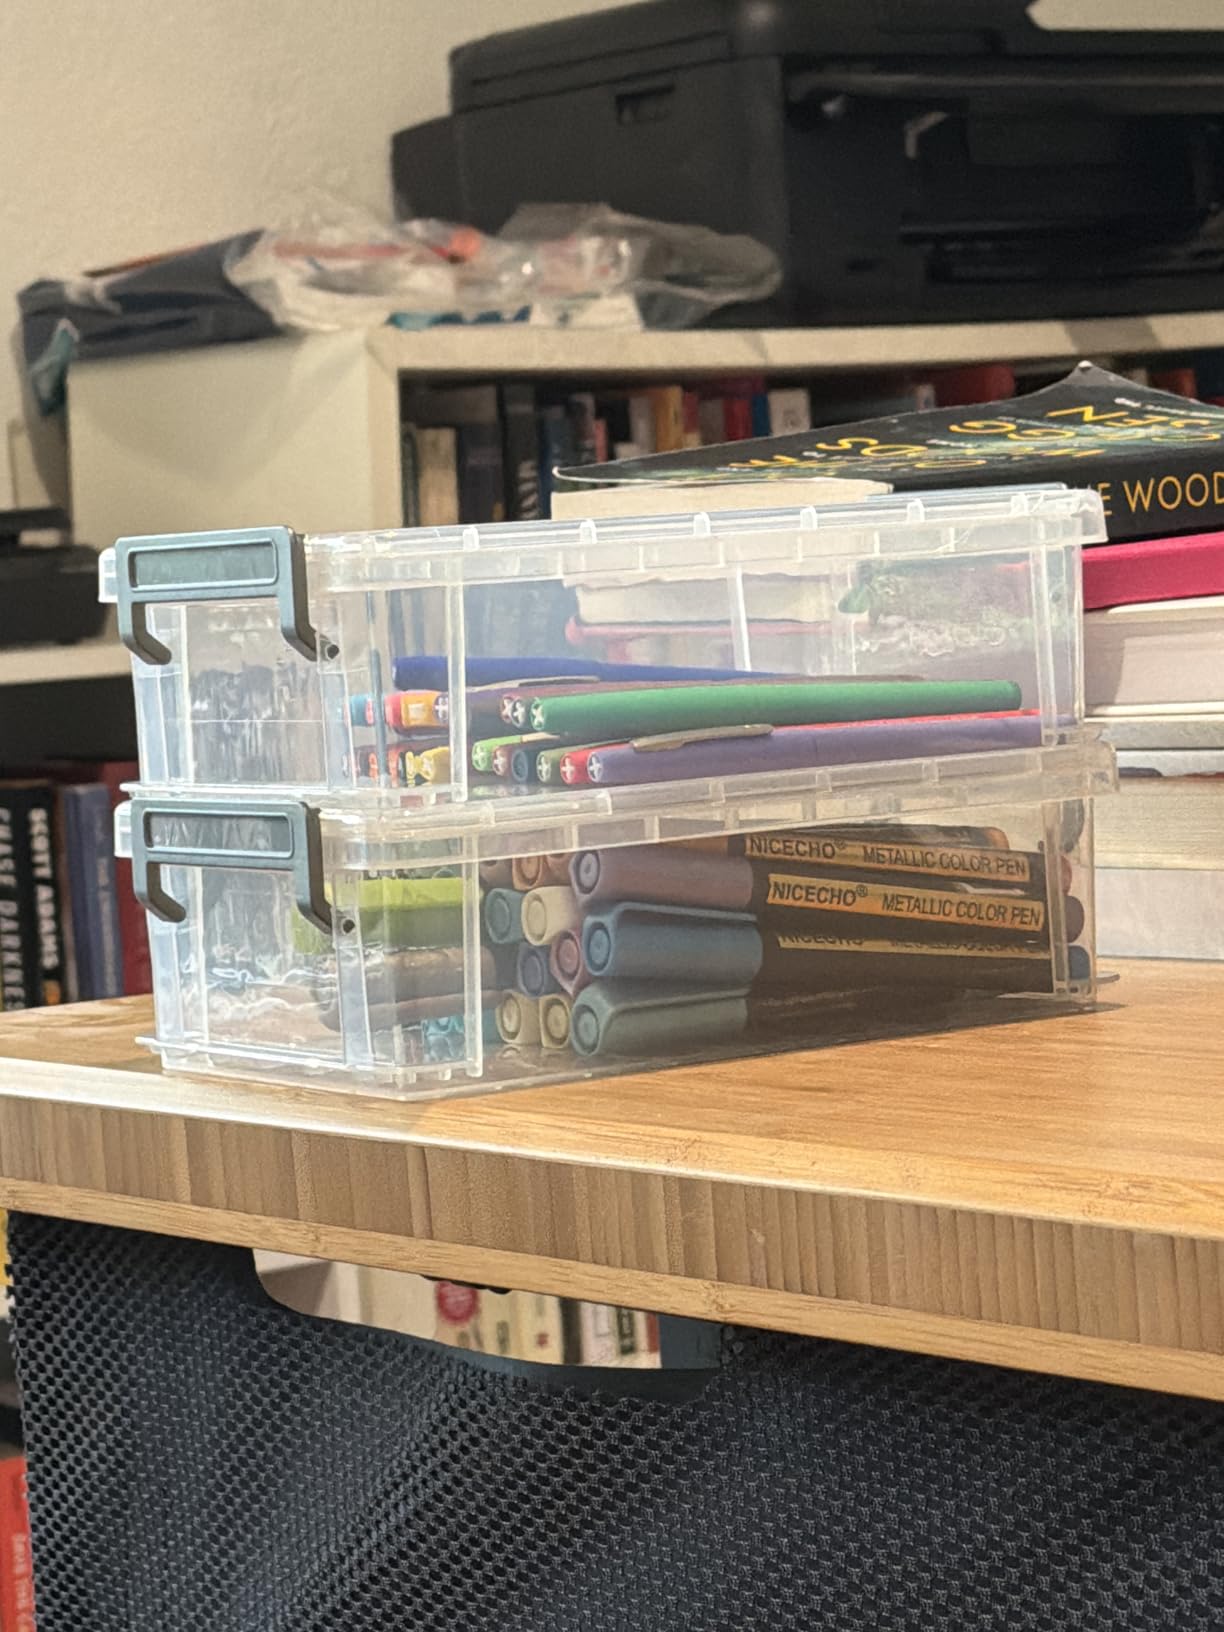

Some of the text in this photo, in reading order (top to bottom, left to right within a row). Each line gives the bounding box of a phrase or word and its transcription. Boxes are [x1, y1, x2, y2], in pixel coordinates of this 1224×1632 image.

[863, 845, 936, 869] METALLIC
[939, 852, 992, 873] COLOR
[996, 857, 1027, 876] PEN
[35, 884, 59, 970] ADAMS
[881, 893, 953, 917] METALLIC
[956, 901, 1007, 923] COLOR
[1010, 906, 1042, 927] PEN
